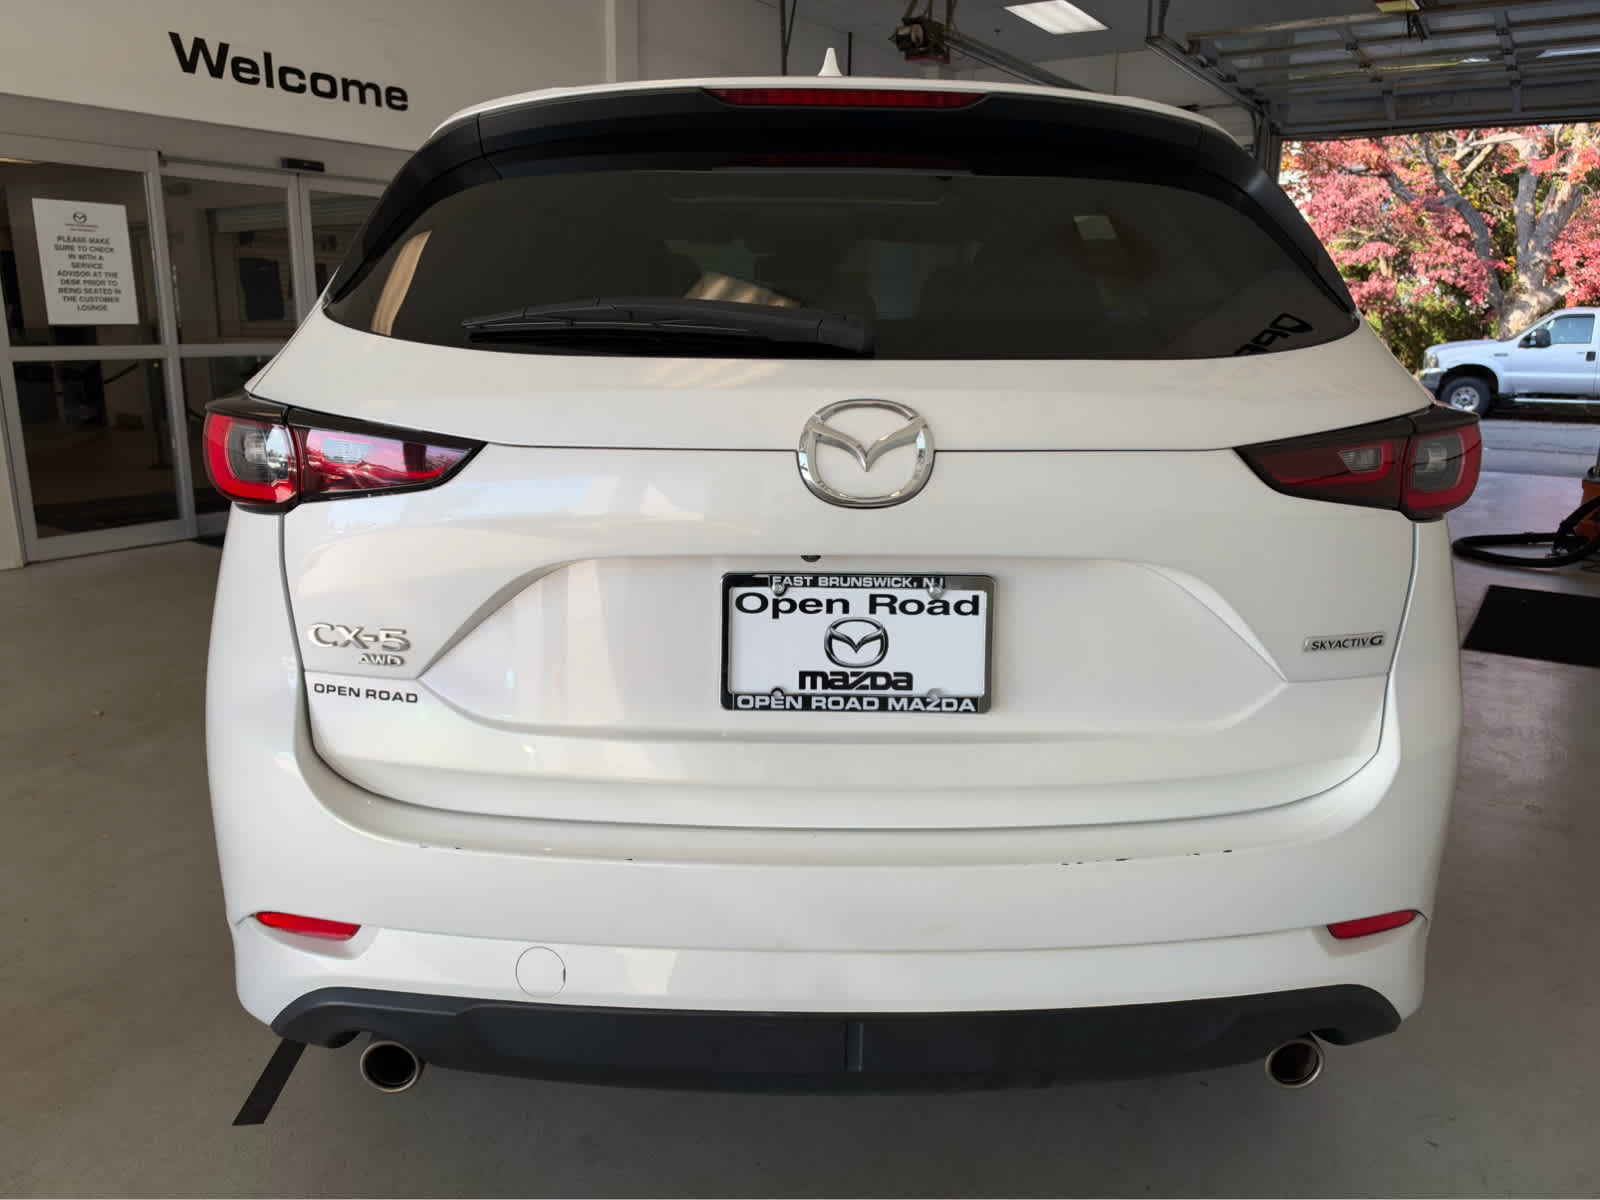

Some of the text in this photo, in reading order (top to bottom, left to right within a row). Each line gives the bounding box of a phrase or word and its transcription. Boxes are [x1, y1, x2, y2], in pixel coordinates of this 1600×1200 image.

[168, 31, 409, 112] Welcome
[57, 235, 87, 243] PLEASE
[83, 287, 112, 295] SEATED
[77, 304, 108, 312] LOUNGE
[818, 576, 917, 589] BRUNSWICK,
[735, 592, 980, 619] Open Road
[308, 622, 411, 652] CX-5
[358, 653, 405, 666] AWD
[798, 671, 913, 691] mazda
[313, 683, 419, 703] OPEN ROAD
[736, 695, 976, 712] OPEN ROAD MAZDA
